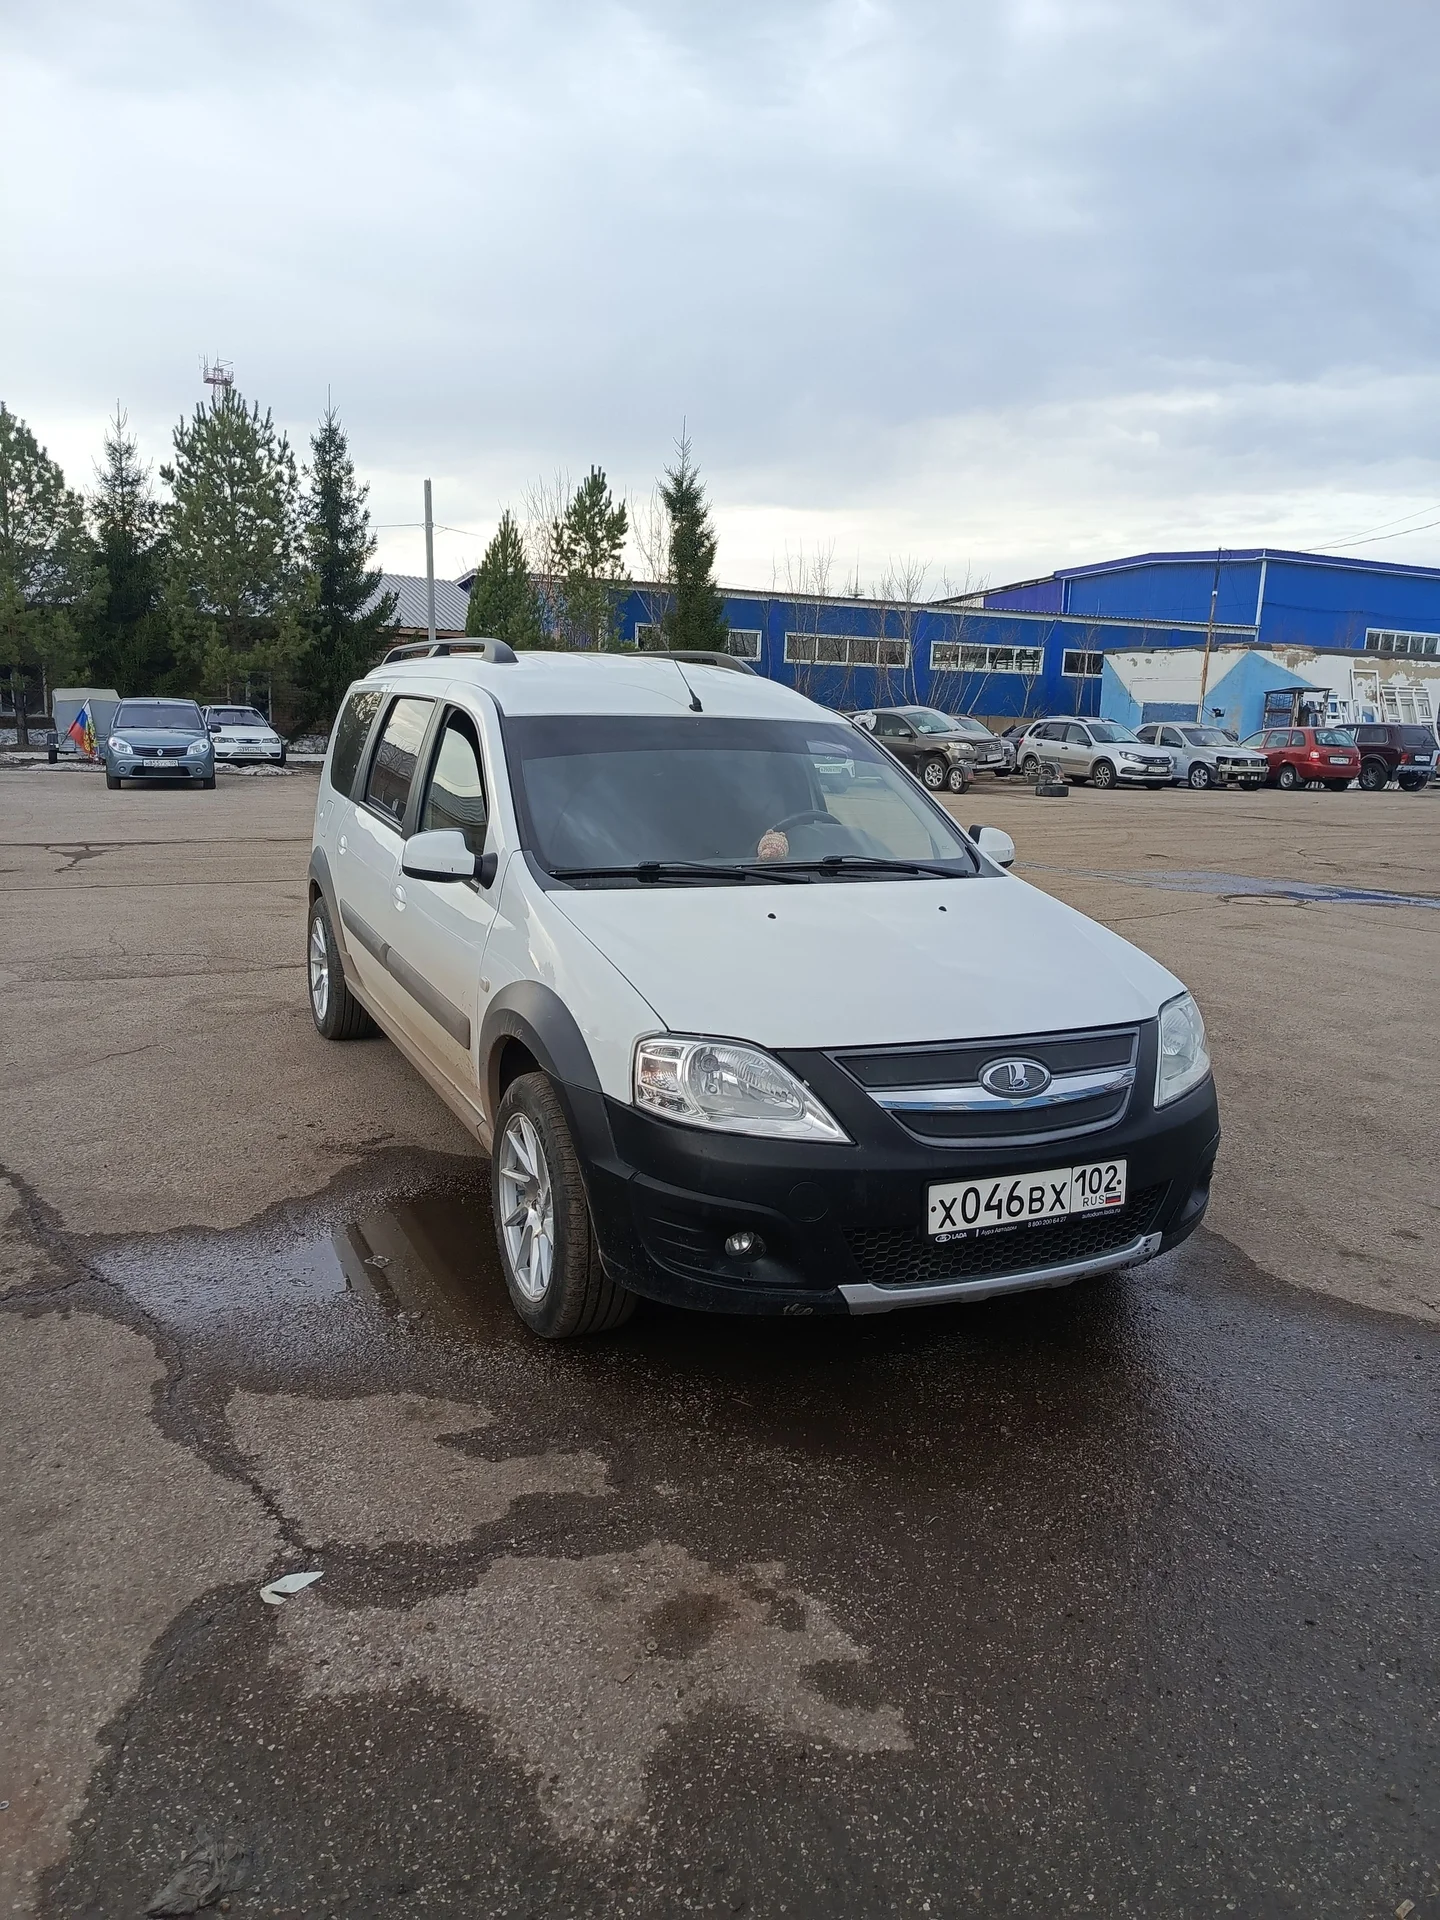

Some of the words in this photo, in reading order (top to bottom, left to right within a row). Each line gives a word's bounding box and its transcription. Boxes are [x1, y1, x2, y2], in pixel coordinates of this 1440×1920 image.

[938, 1180, 1067, 1229] Х046ВХ
[1074, 1165, 1118, 1196] 102
[1082, 1195, 1105, 1207] RUS
[951, 1232, 968, 1240] LADA
